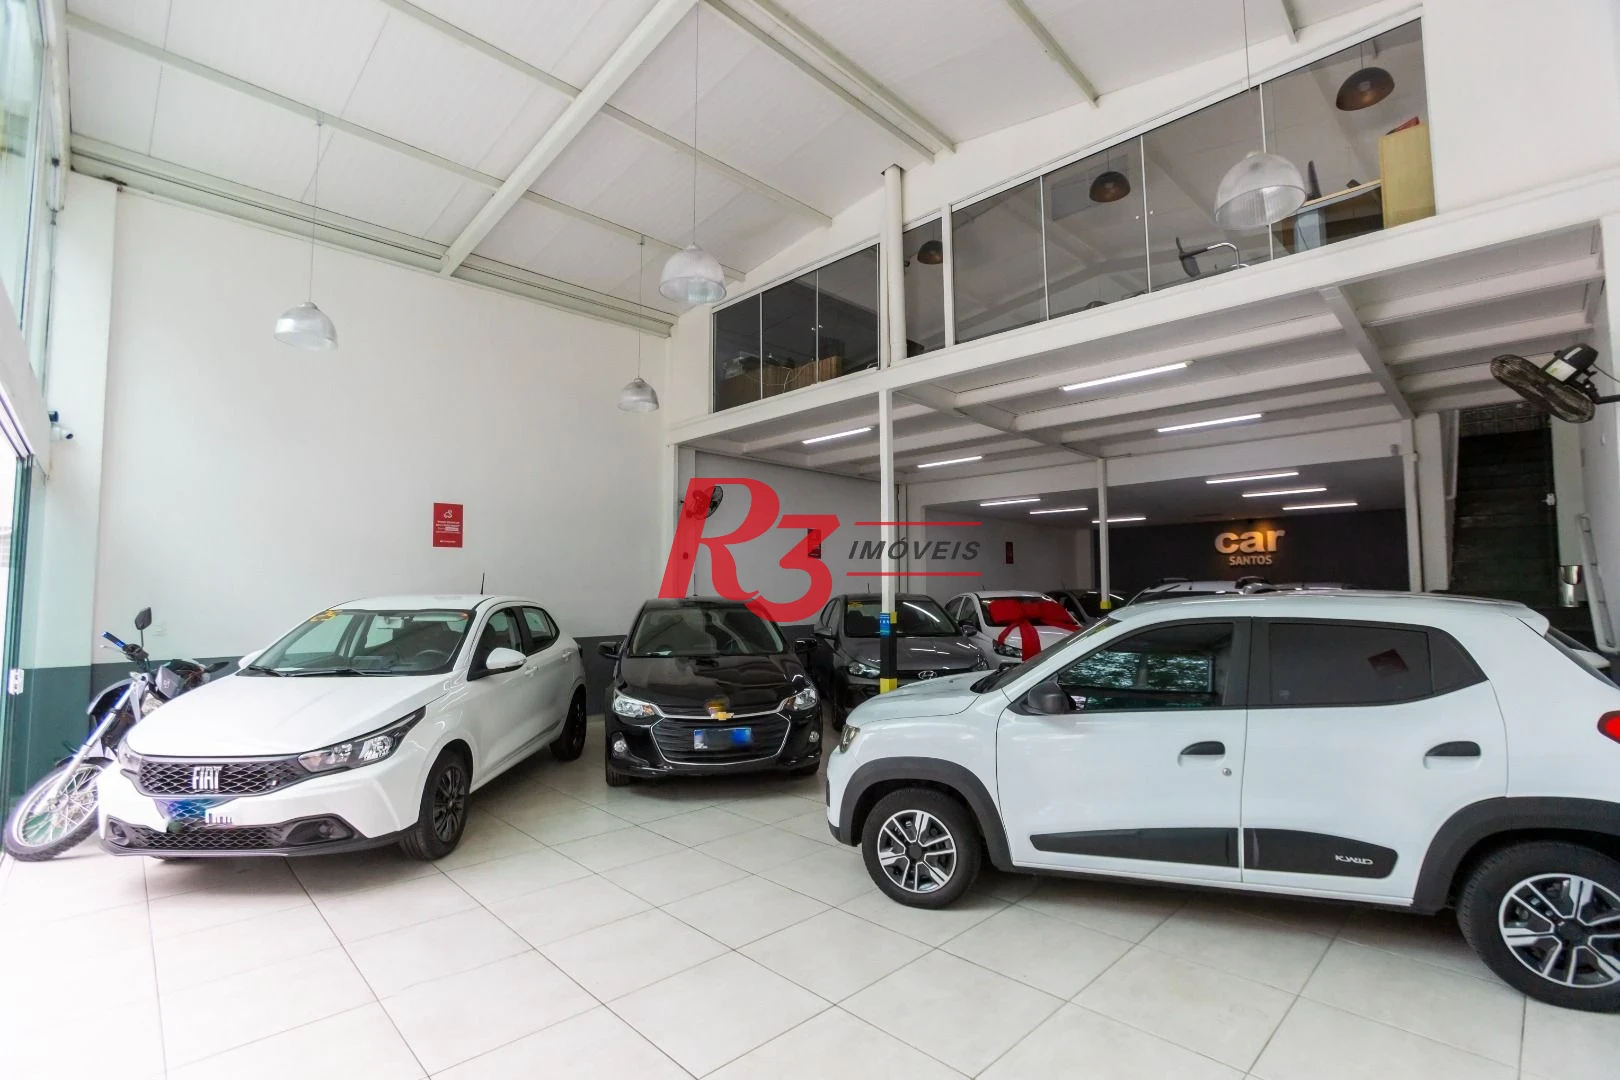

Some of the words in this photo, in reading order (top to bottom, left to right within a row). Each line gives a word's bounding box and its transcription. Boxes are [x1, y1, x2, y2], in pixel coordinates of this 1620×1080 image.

[1214, 530, 1286, 554] car
[1229, 555, 1272, 566] SANTOS
[192, 766, 222, 790] FIAT
[1334, 854, 1374, 865] KWID
